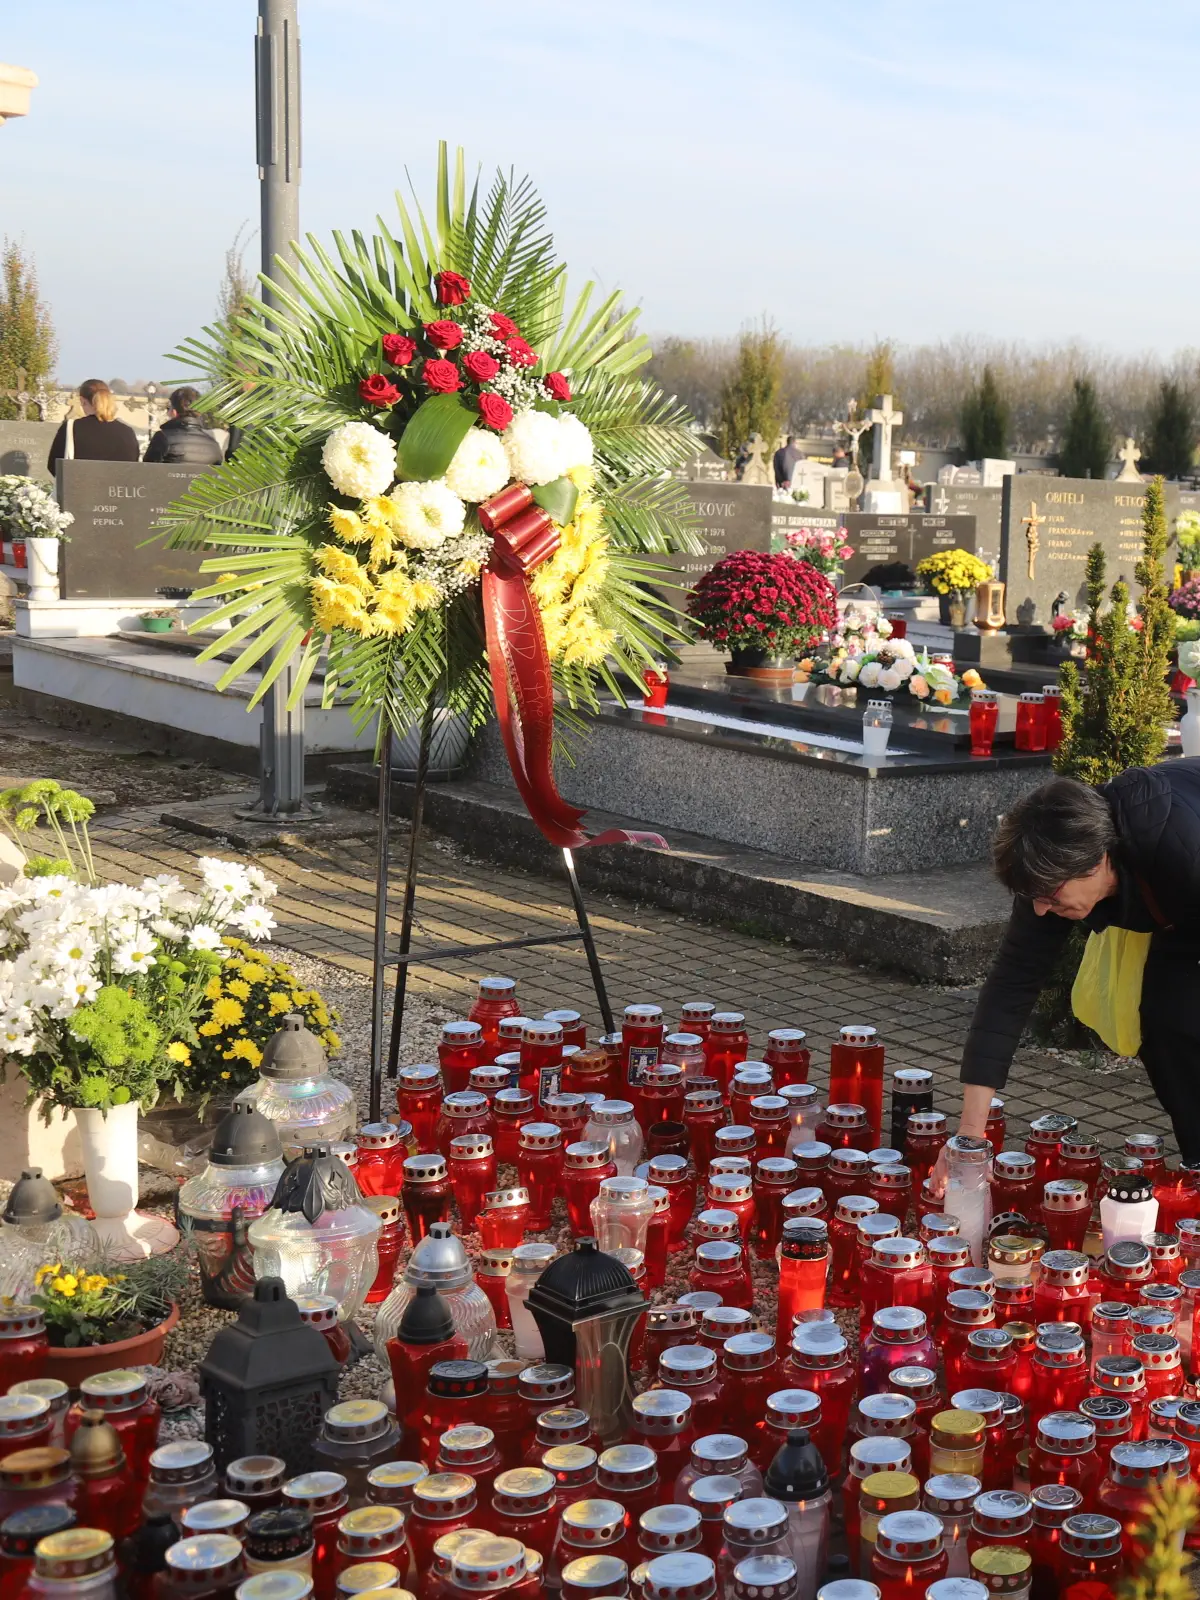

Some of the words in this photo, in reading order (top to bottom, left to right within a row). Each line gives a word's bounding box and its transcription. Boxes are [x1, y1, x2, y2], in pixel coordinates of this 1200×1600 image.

[1045, 492, 1084, 505] OBITELJ
[92, 505, 118, 513] JOSIP
[93, 518, 124, 526] PEPICA
